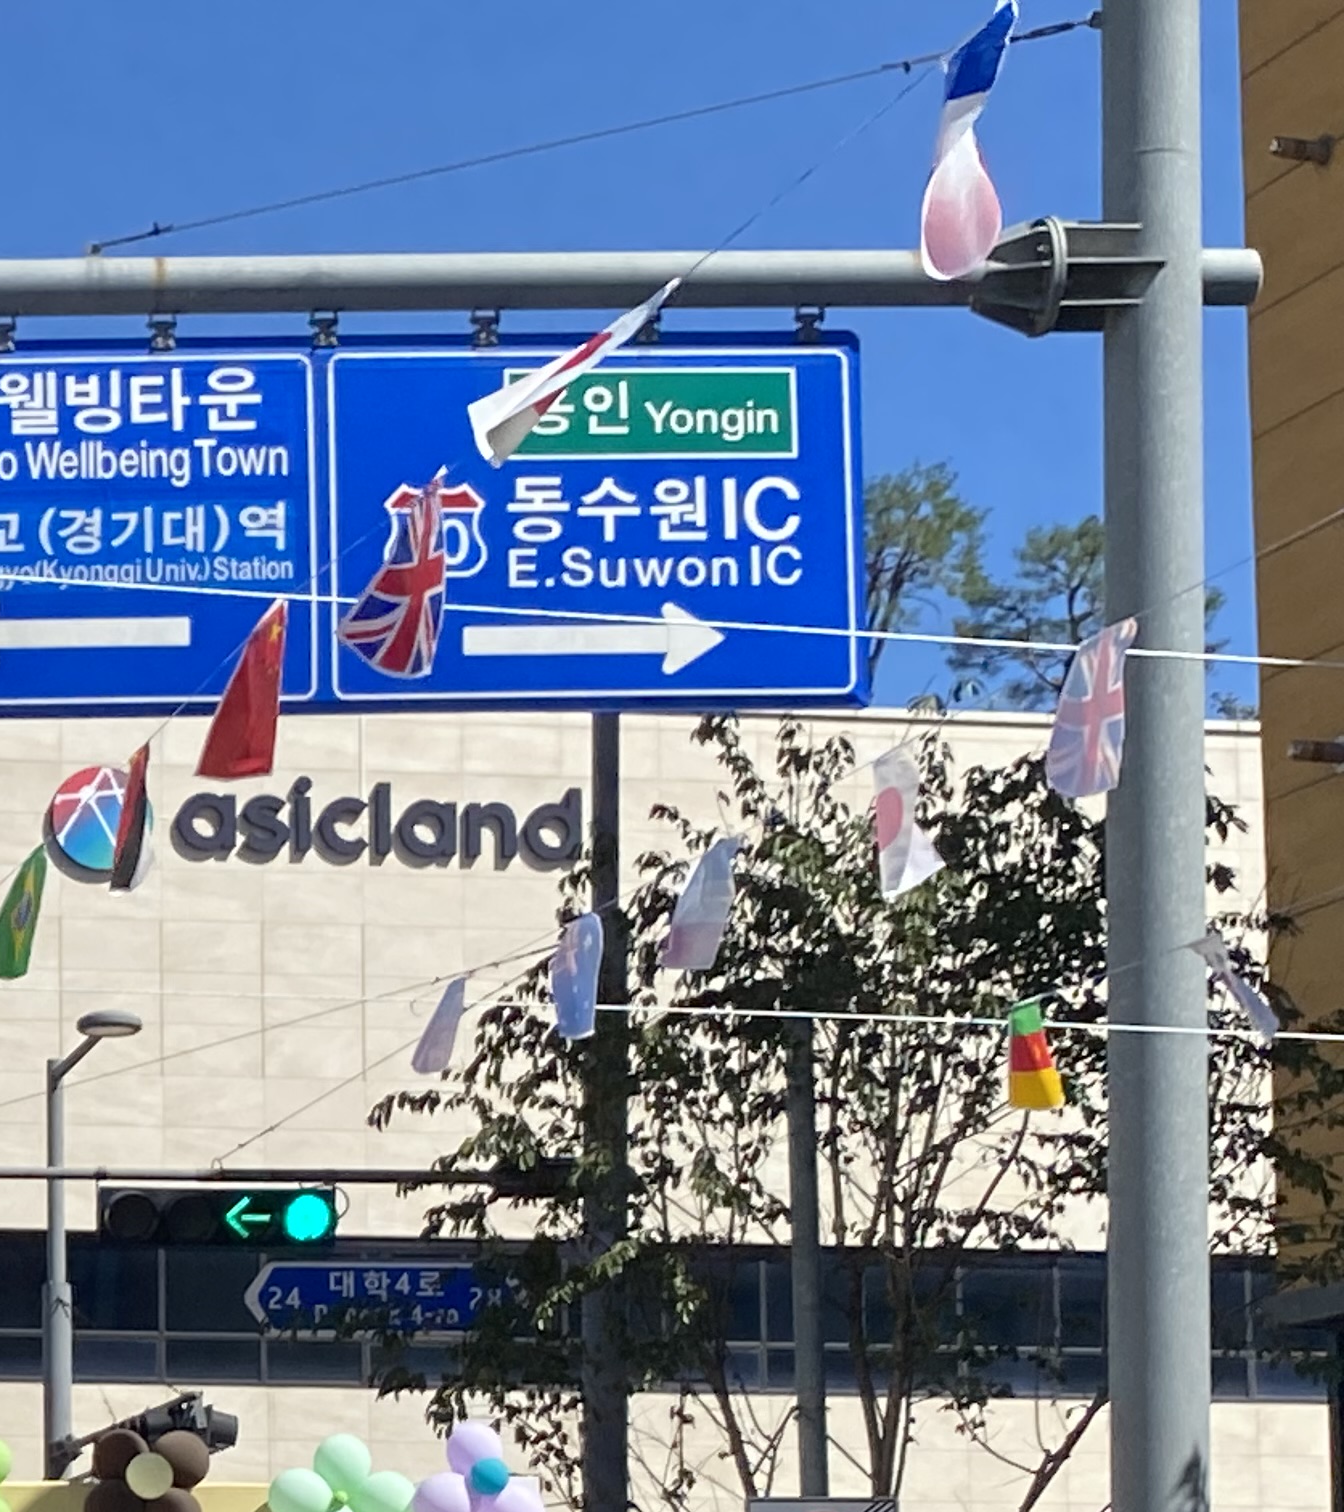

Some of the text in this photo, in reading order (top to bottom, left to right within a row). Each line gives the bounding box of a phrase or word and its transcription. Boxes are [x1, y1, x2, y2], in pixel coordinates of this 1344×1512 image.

[644, 400, 780, 442] Yongin
[25, 439, 192, 487] Wellbeing
[192, 437, 289, 477] Town
[213, 555, 294, 581] Station
[507, 544, 803, 589] E.Suwon IC
[169, 776, 584, 870] asicland
[267, 1286, 302, 1310] 24
[328, 1270, 446, 1302] 대학4로
